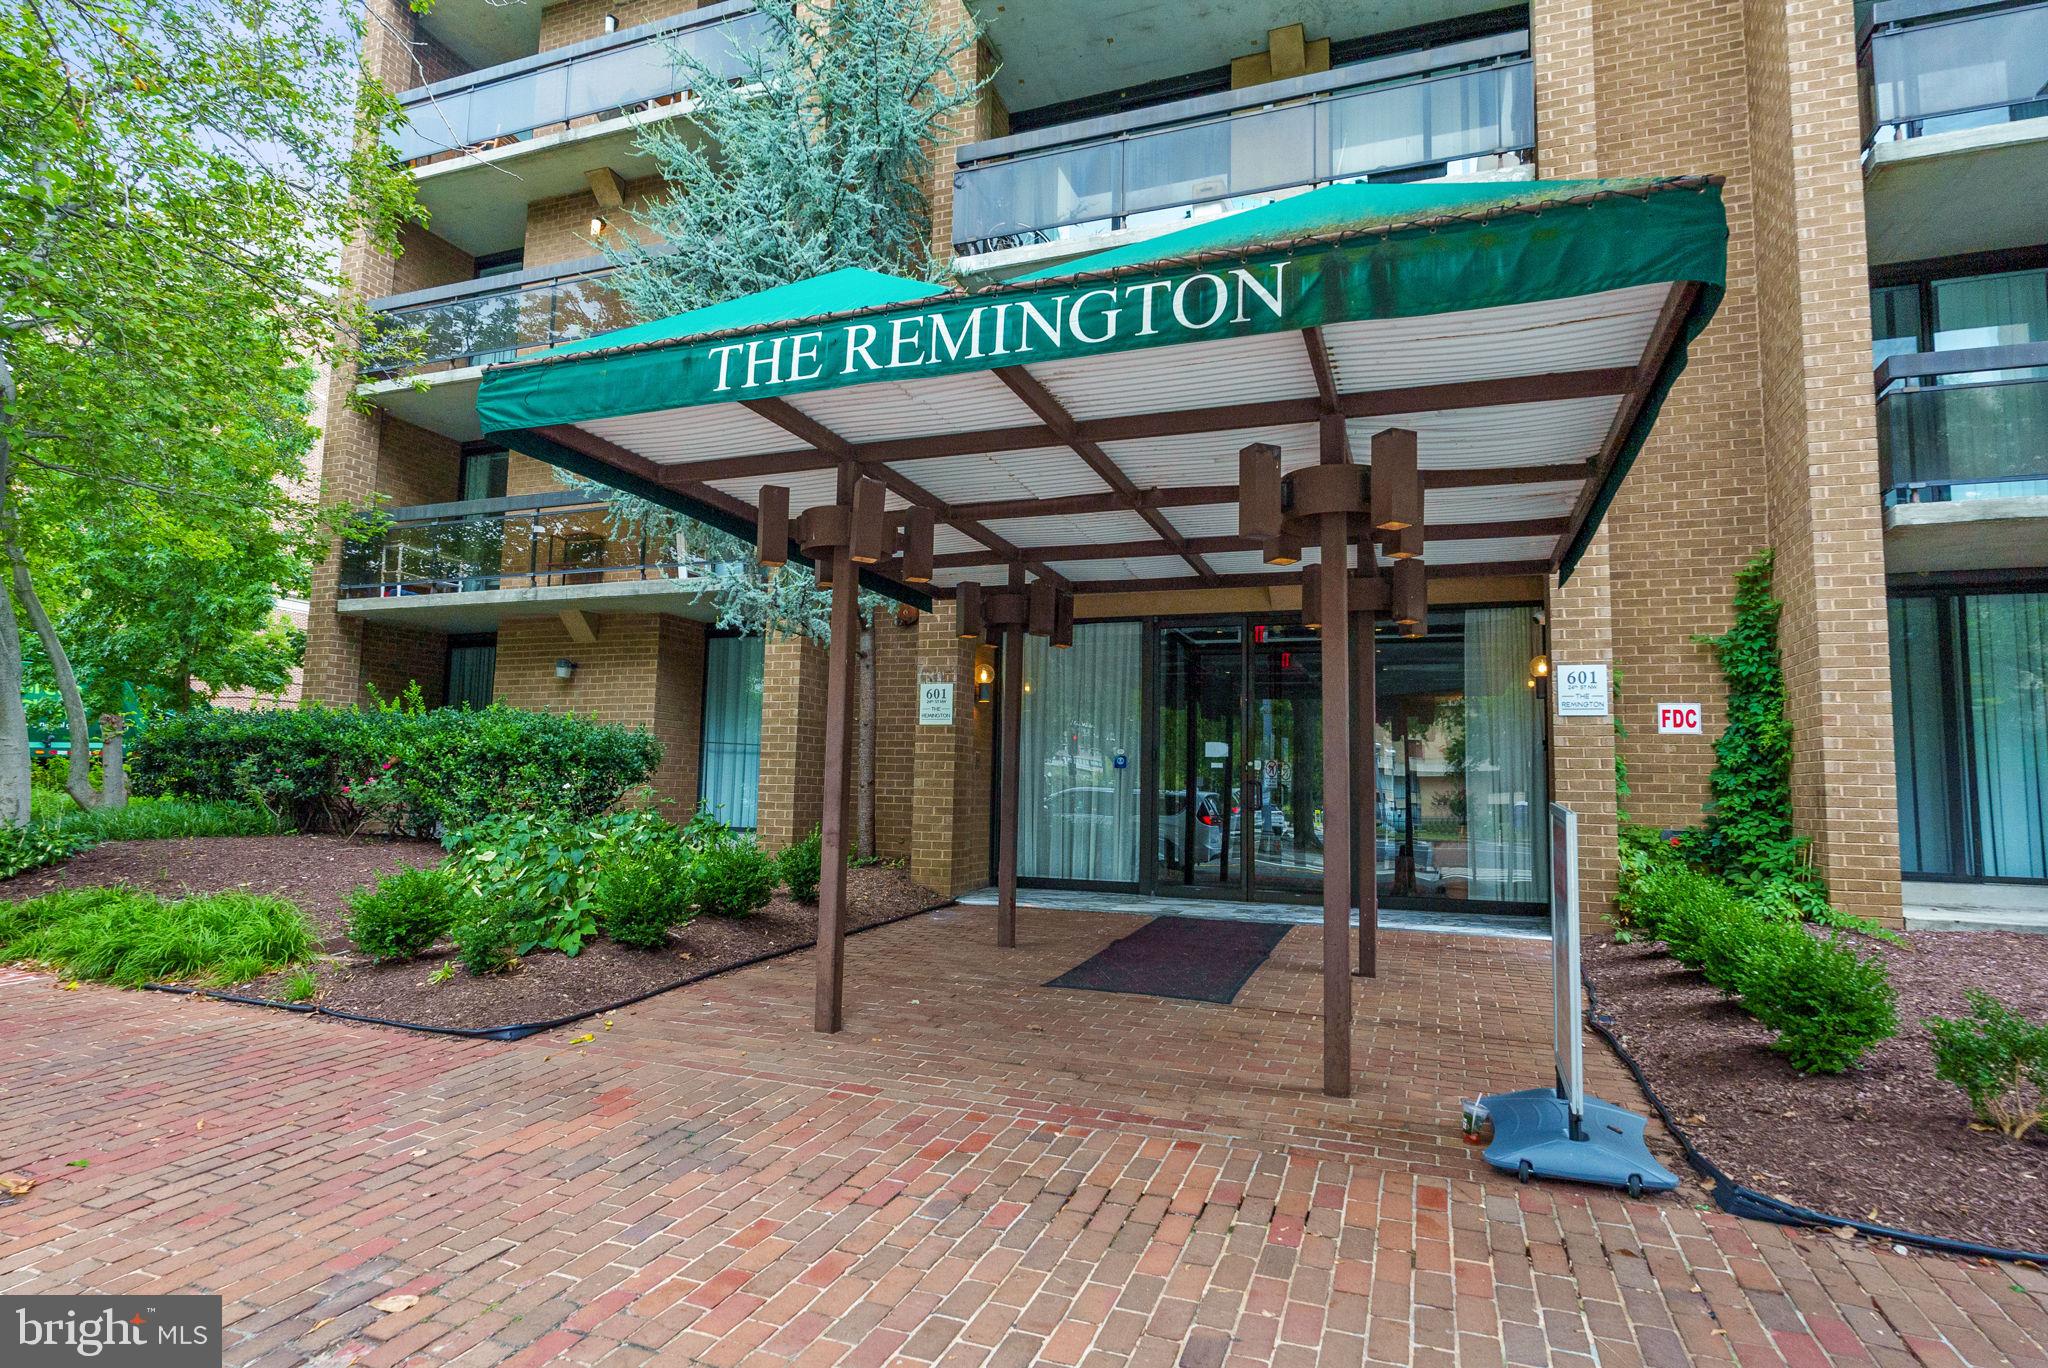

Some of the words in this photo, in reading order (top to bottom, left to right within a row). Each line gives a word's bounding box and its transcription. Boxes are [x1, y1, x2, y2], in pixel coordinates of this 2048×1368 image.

[709, 331, 823, 392] THE
[839, 261, 1292, 375] REMINGTON
[1567, 670, 1598, 685] 601
[926, 688, 947, 700] 601
[1661, 709, 1697, 728] FDC
